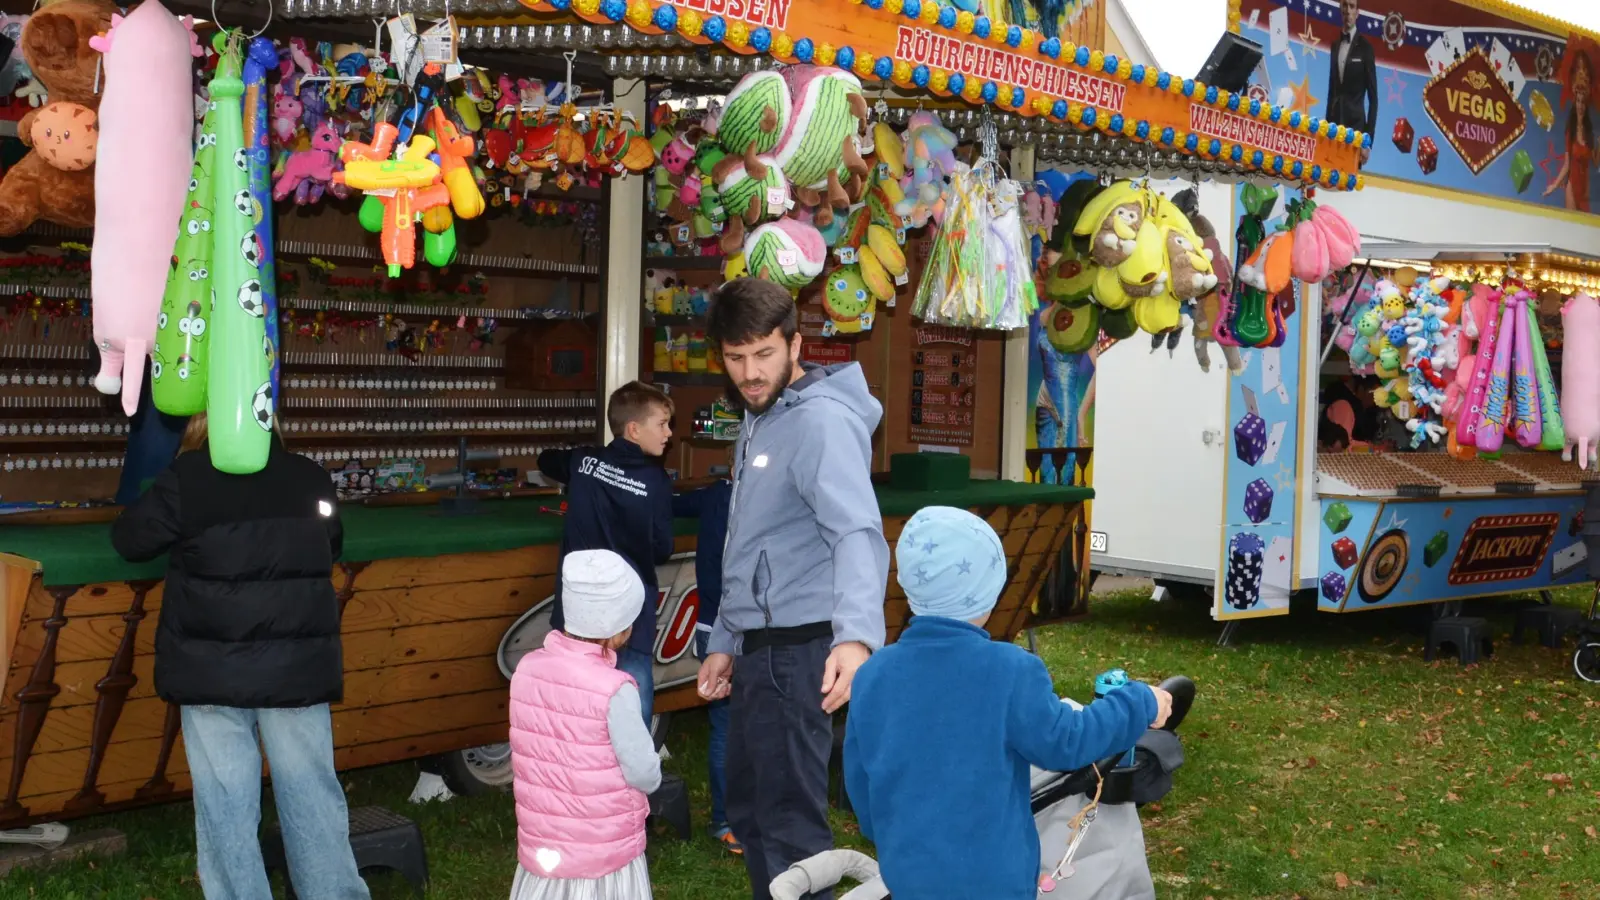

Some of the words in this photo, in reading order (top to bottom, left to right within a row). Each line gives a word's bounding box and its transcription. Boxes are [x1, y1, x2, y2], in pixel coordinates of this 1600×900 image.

[896, 25, 1127, 112] RÖHRCHENSCHIESSEN
[1446, 88, 1506, 124] VEGAS
[1189, 103, 1316, 161] WALZENSCHIESSEN
[1455, 121, 1496, 144] CASINO
[1486, 376, 1507, 424] BOOM!
[1516, 376, 1534, 423] BOOM!
[578, 456, 598, 475] SG
[1467, 535, 1542, 565] JACKPOT
